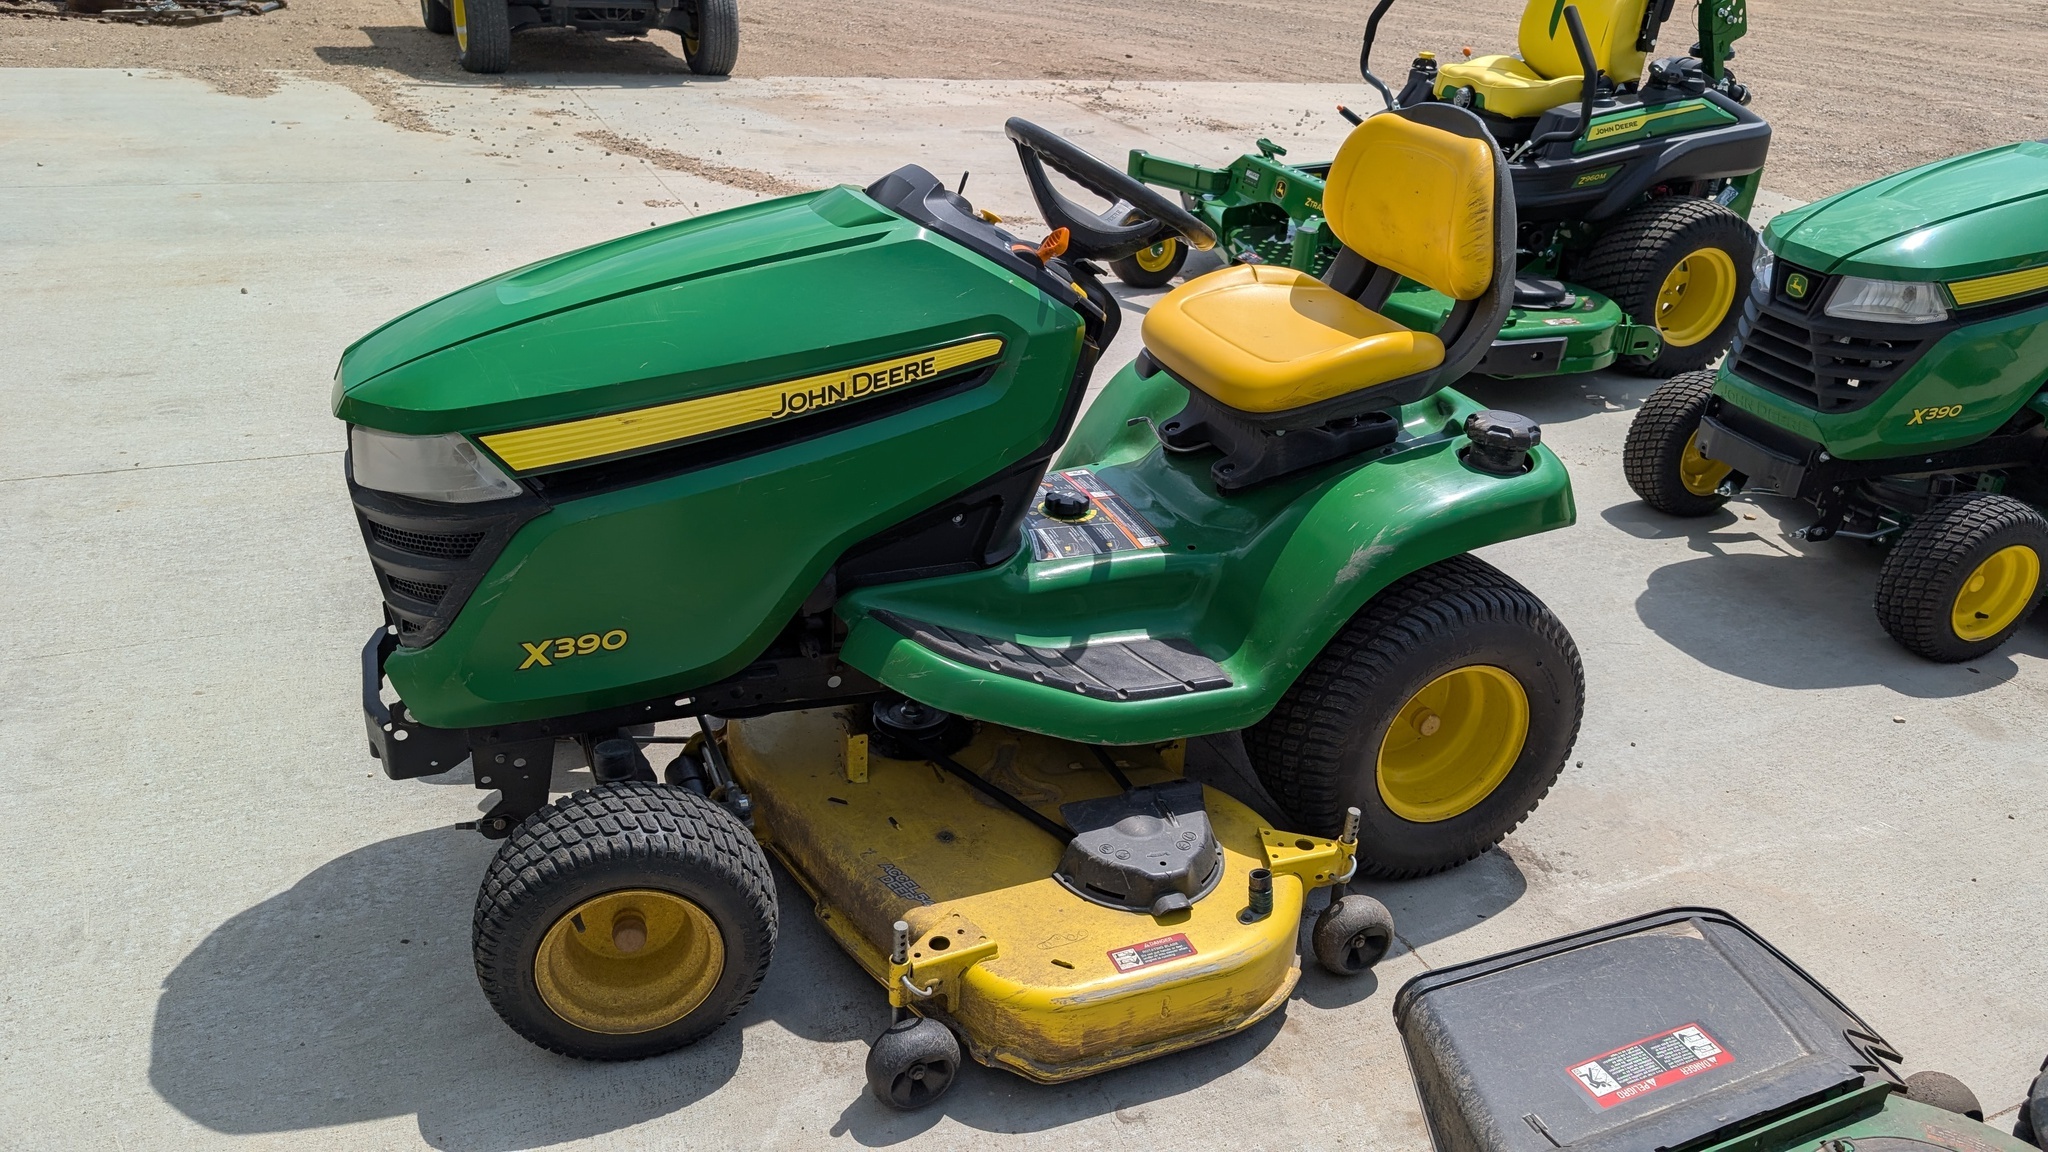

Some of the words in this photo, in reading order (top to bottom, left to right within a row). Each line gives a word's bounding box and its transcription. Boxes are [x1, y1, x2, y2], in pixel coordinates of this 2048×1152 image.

[1595, 127, 1614, 135] JOHN
[1615, 121, 1638, 131] DEERE
[1578, 173, 1607, 185] Z960M
[1305, 197, 1323, 211] ZTRA
[771, 381, 846, 418] JOHN
[852, 356, 937, 397] DEERE
[1720, 384, 1753, 411] JOHN
[1757, 400, 1811, 434] DEERE
[1906, 404, 1963, 426] X390
[516, 629, 628, 671] X390
[878, 864, 920, 894] ACCEL
[878, 875, 915, 899] DEEP
[1149, 937, 1173, 947] DANGER
[1681, 1059, 1712, 1075] DANGER
[1616, 1082, 1650, 1099] PELIGRO
